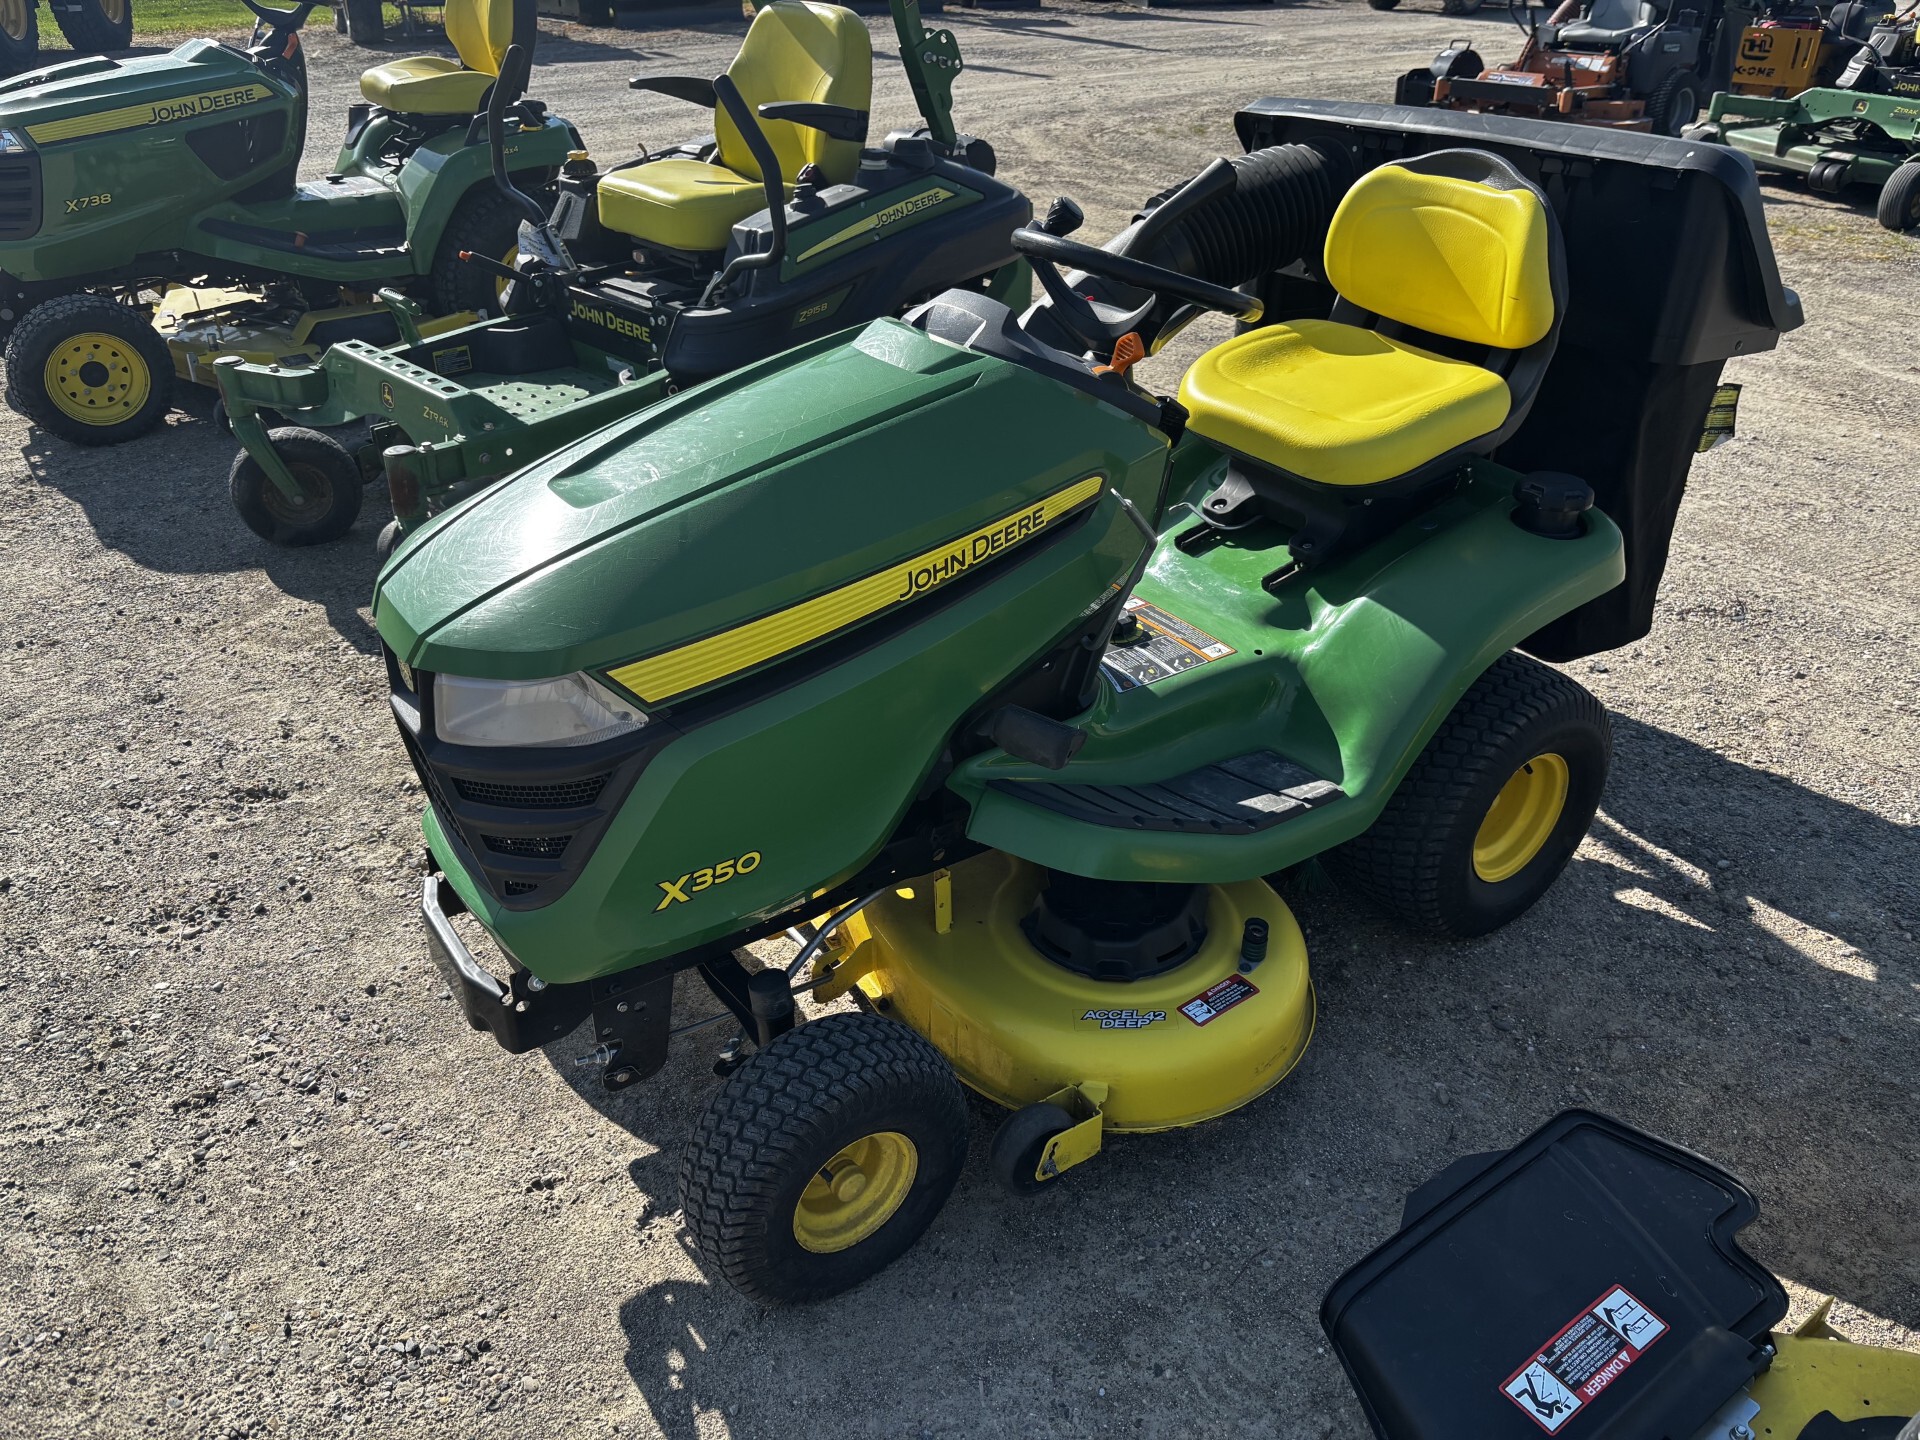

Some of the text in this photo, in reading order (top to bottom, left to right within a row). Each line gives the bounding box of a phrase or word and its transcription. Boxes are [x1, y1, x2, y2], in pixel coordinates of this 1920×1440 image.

[147, 88, 256, 123] JOHN DEERE
[1894, 106, 1919, 115] ZTRAK
[64, 193, 112, 214] X738
[875, 191, 942, 228] JOHN DEERE
[570, 299, 651, 343] JOHN DEERE
[422, 405, 449, 429] ZTRAK
[899, 505, 1045, 600] JOHN DEERE
[651, 850, 763, 914] X350
[1211, 980, 1231, 993] DANGER
[1081, 1009, 1167, 1021] ACCEL 42
[1100, 1019, 1152, 1029] DEEP
[1566, 1336, 1606, 1372] THROWN OBJECTS
[1580, 1347, 1617, 1381] ROTATING BLADE
[1583, 1359, 1624, 1396] DANGER
